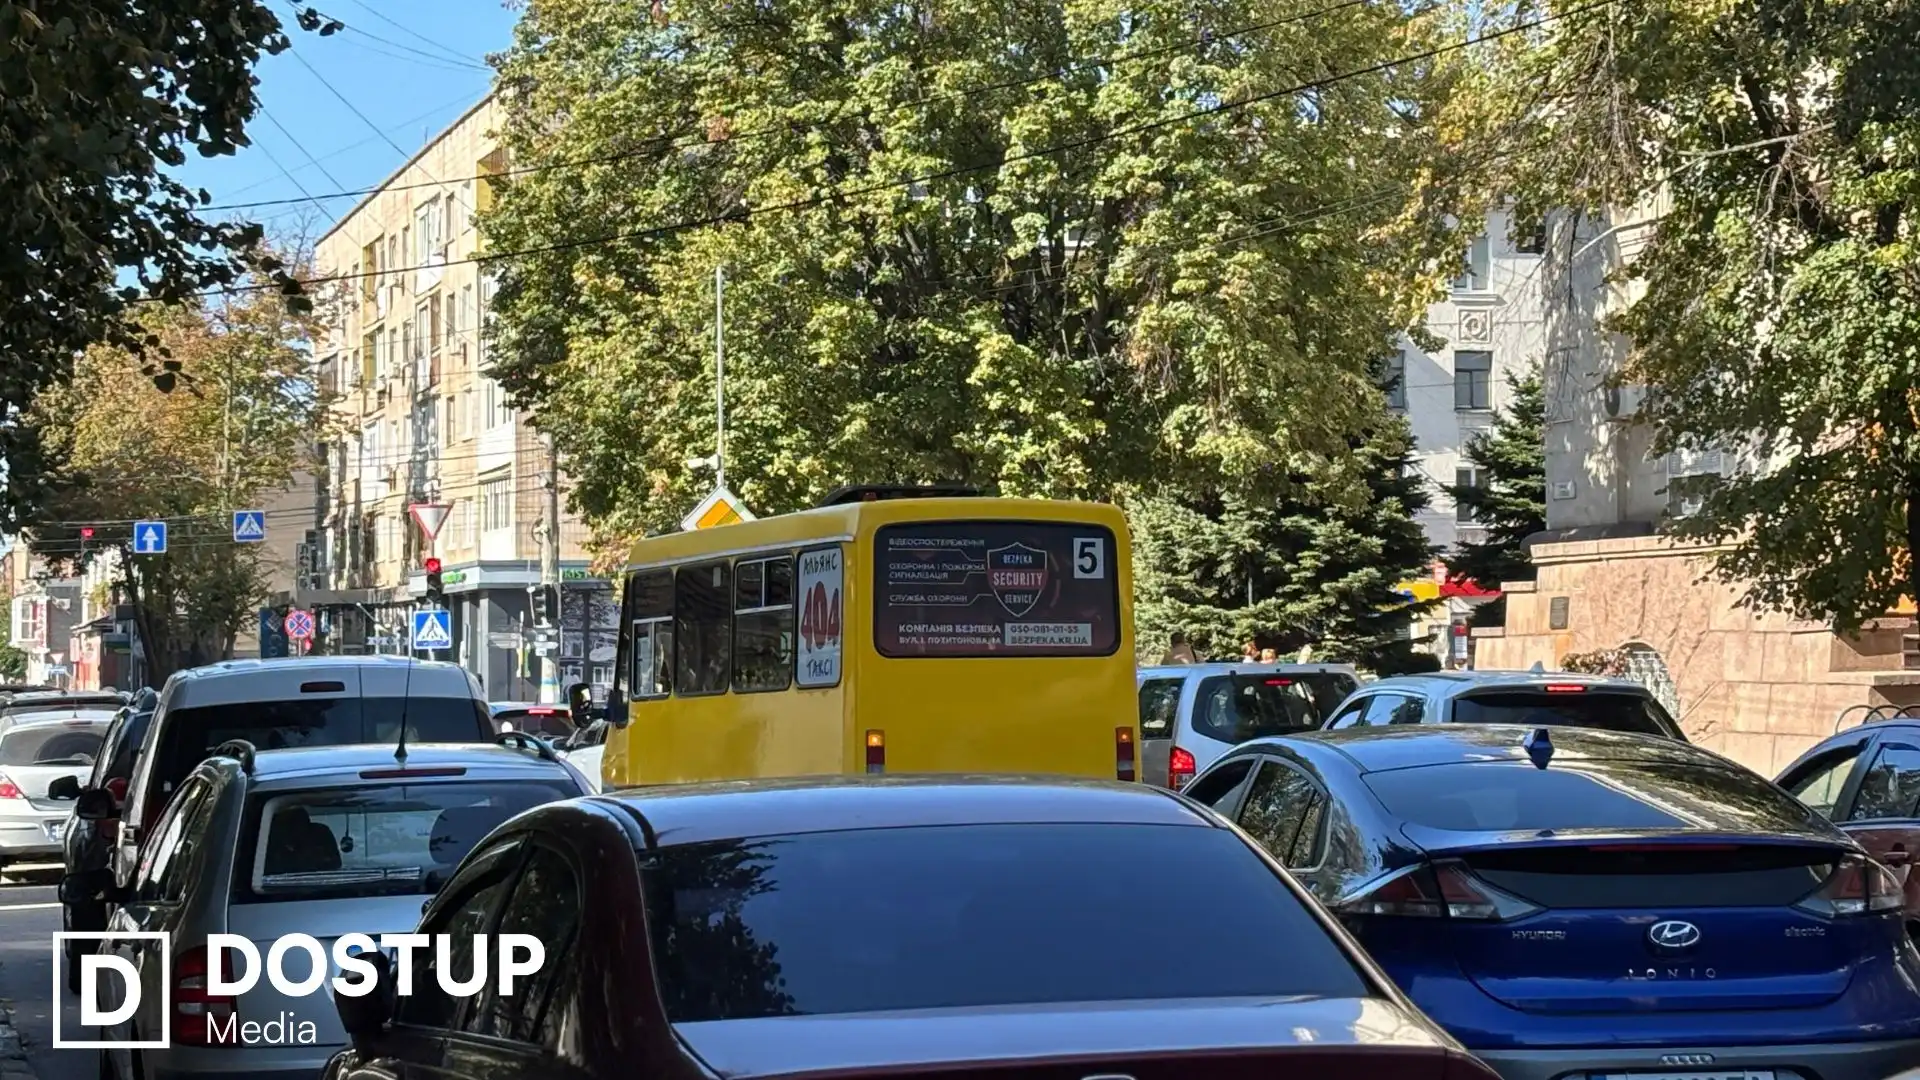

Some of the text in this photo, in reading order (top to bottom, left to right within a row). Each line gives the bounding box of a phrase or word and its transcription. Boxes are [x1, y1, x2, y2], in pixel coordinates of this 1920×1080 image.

[803, 552, 838, 576] АЛЬЯНС
[1078, 542, 1098, 575] 5
[993, 572, 1043, 586] SECURITY
[1004, 594, 1032, 604] SERVICE
[801, 581, 840, 654] 404
[899, 624, 1001, 633] КОМПАНІЯ БЕЗПЕКА
[1512, 930, 1566, 940] HYUNDAI
[1784, 926, 1826, 937] electric
